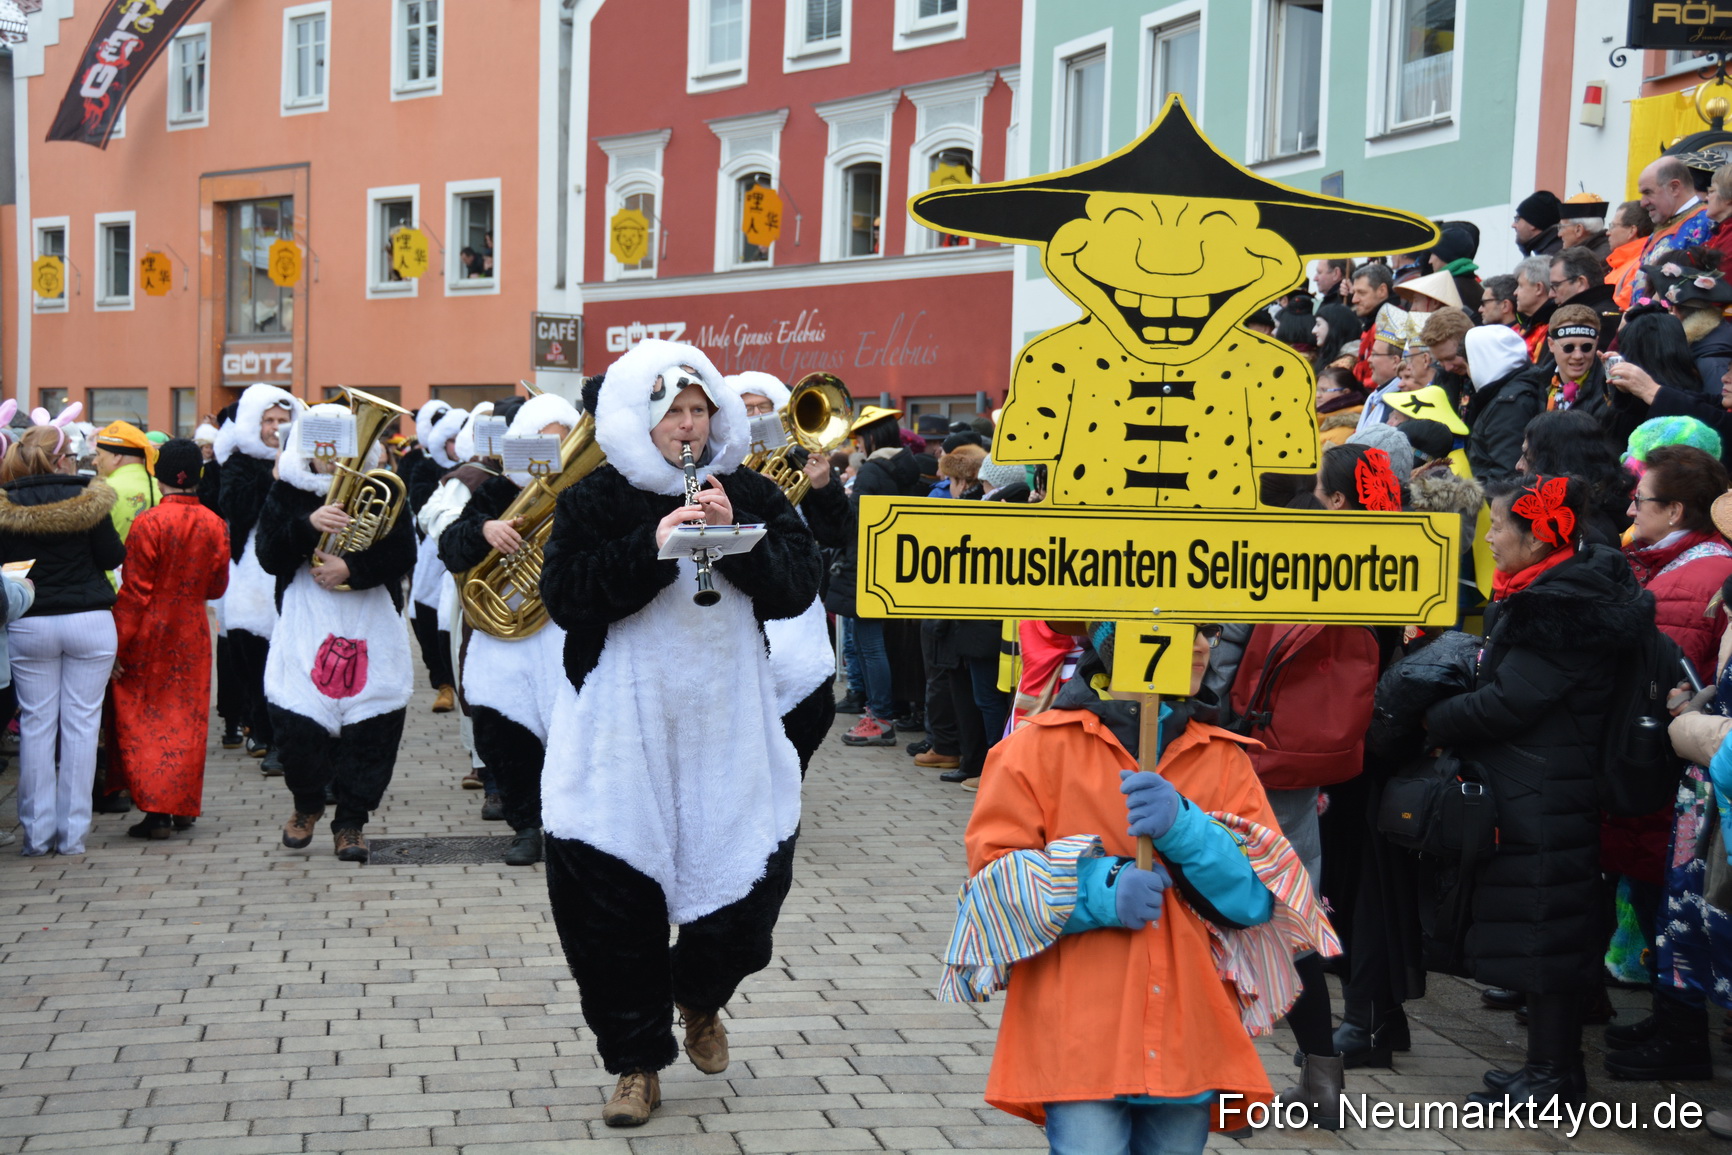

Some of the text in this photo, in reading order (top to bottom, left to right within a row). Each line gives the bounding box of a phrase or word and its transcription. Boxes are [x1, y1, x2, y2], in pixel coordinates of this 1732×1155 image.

[538, 320, 576, 340] CAFÉ
[695, 314, 730, 349] Mode
[734, 323, 773, 357] Genuss
[777, 308, 826, 344] Erlebnis
[854, 310, 940, 368] Erlebnis
[1565, 327, 1590, 335] PEACE
[223, 350, 292, 375] GÖTZ
[896, 532, 1419, 602] Dorfmusikanten Seligenporten
[1139, 634, 1171, 682] 7
